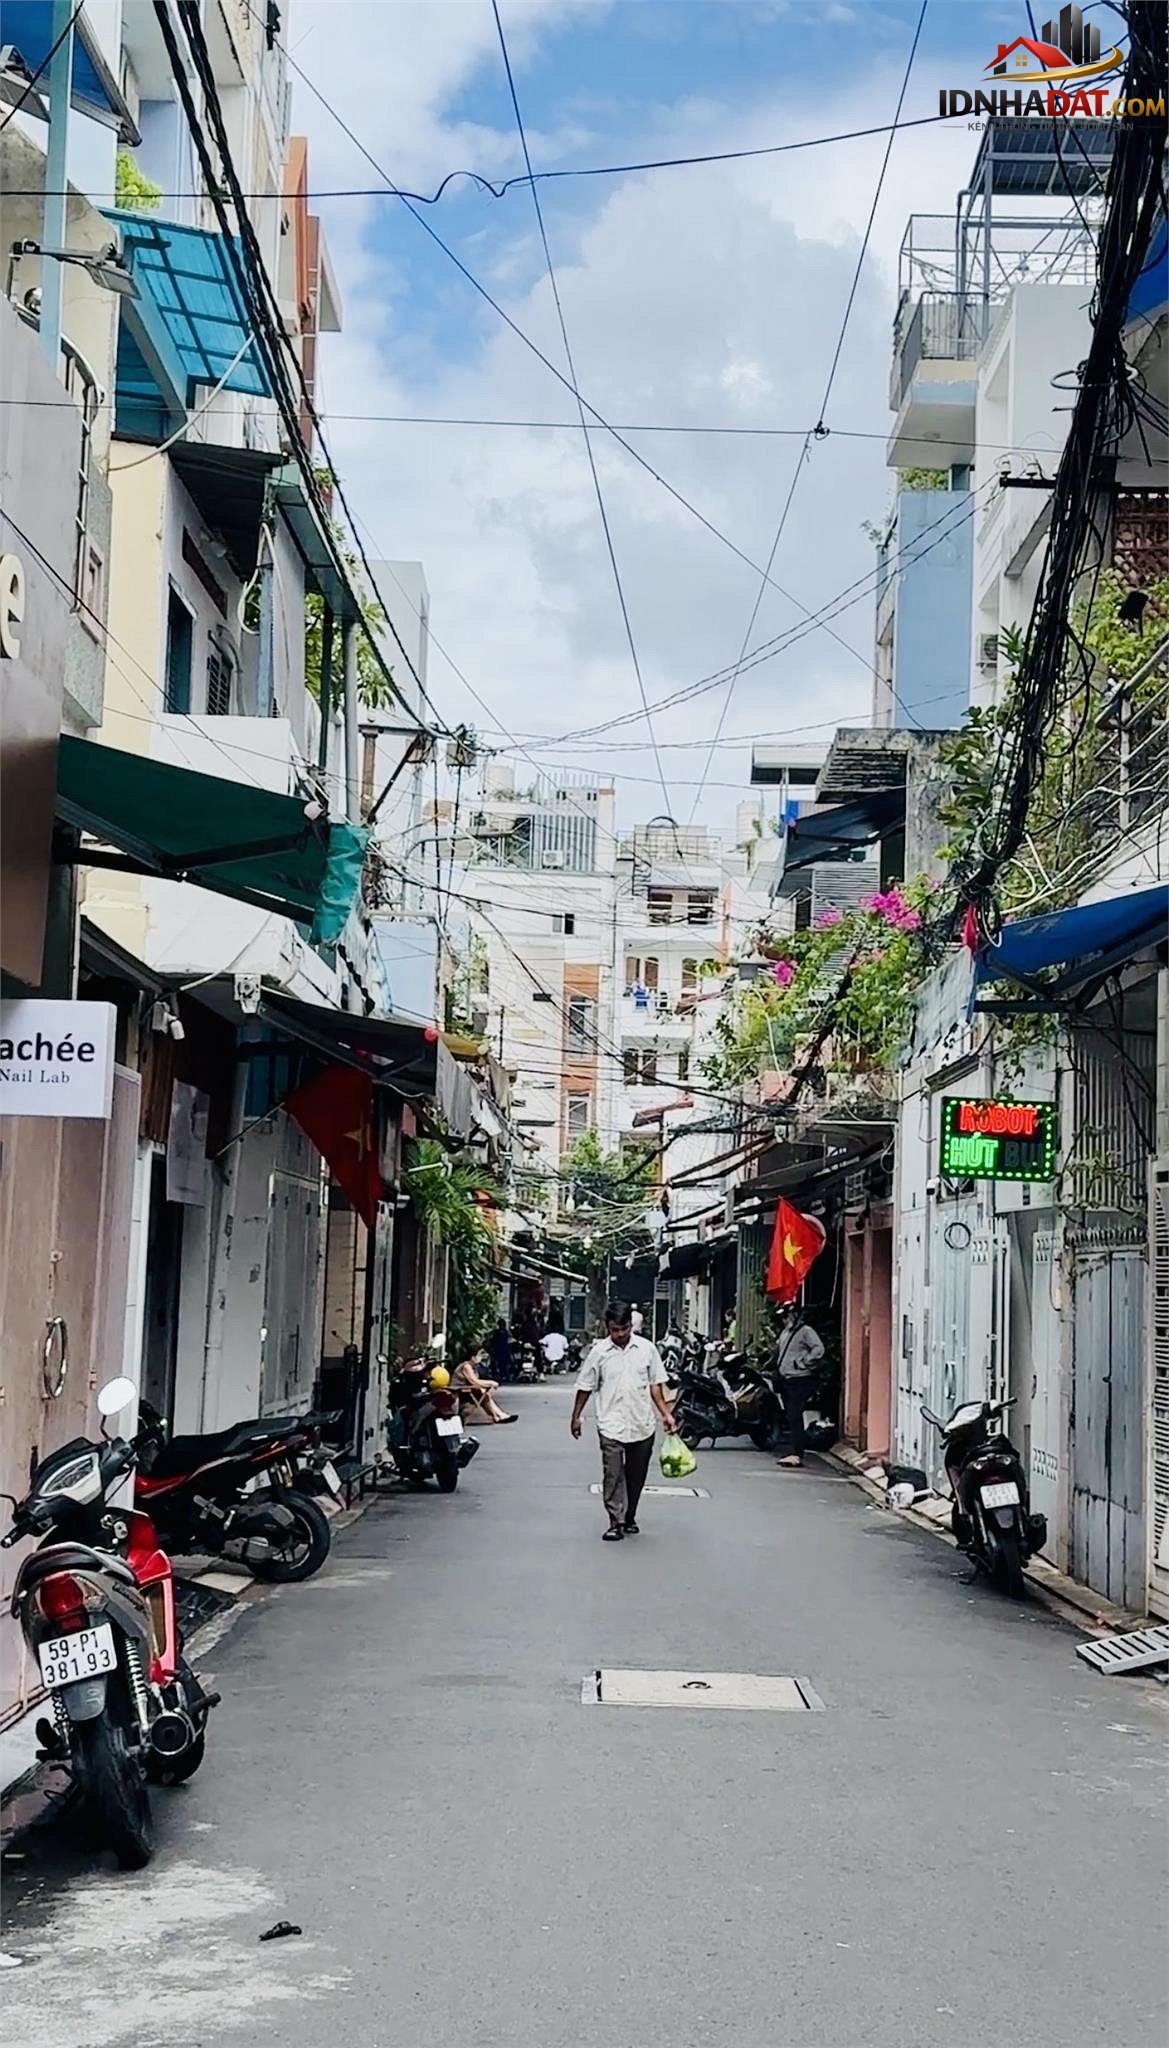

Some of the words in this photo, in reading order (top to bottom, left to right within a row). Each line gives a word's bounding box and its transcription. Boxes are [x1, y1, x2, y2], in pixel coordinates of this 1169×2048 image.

[0, 1032, 95, 1062] achée
[0, 1068, 32, 1083] Nail
[40, 1069, 70, 1083] Lab
[959, 1103, 1038, 1136] ROBOT
[949, 1131, 999, 1168] HÚT
[48, 1630, 98, 1661] 59-P1
[44, 1648, 111, 1684] 381.93
